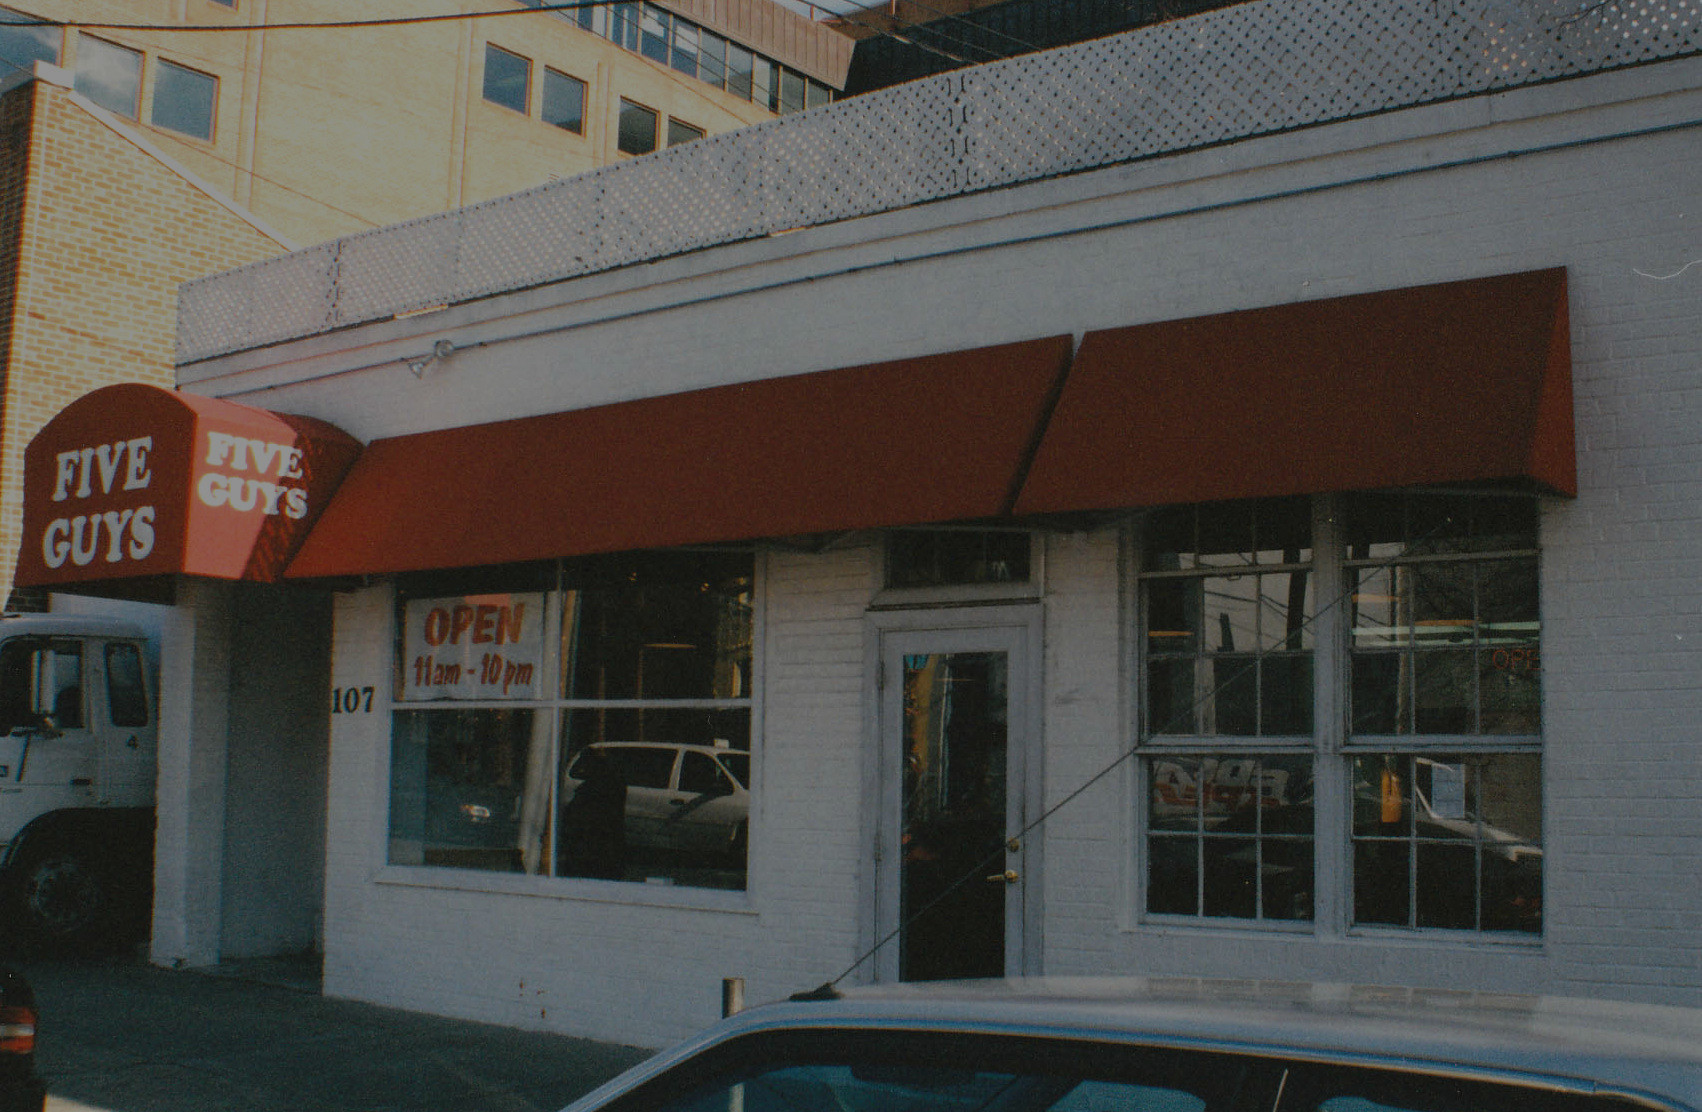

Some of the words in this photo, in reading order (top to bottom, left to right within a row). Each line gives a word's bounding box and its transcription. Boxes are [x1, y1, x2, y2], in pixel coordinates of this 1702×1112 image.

[52, 436, 152, 502] FIVE
[206, 431, 304, 479] FIVE
[198, 472, 309, 520] GUYS
[42, 505, 156, 569] GUYS
[425, 603, 525, 646] OPEN
[332, 686, 374, 714] 107
